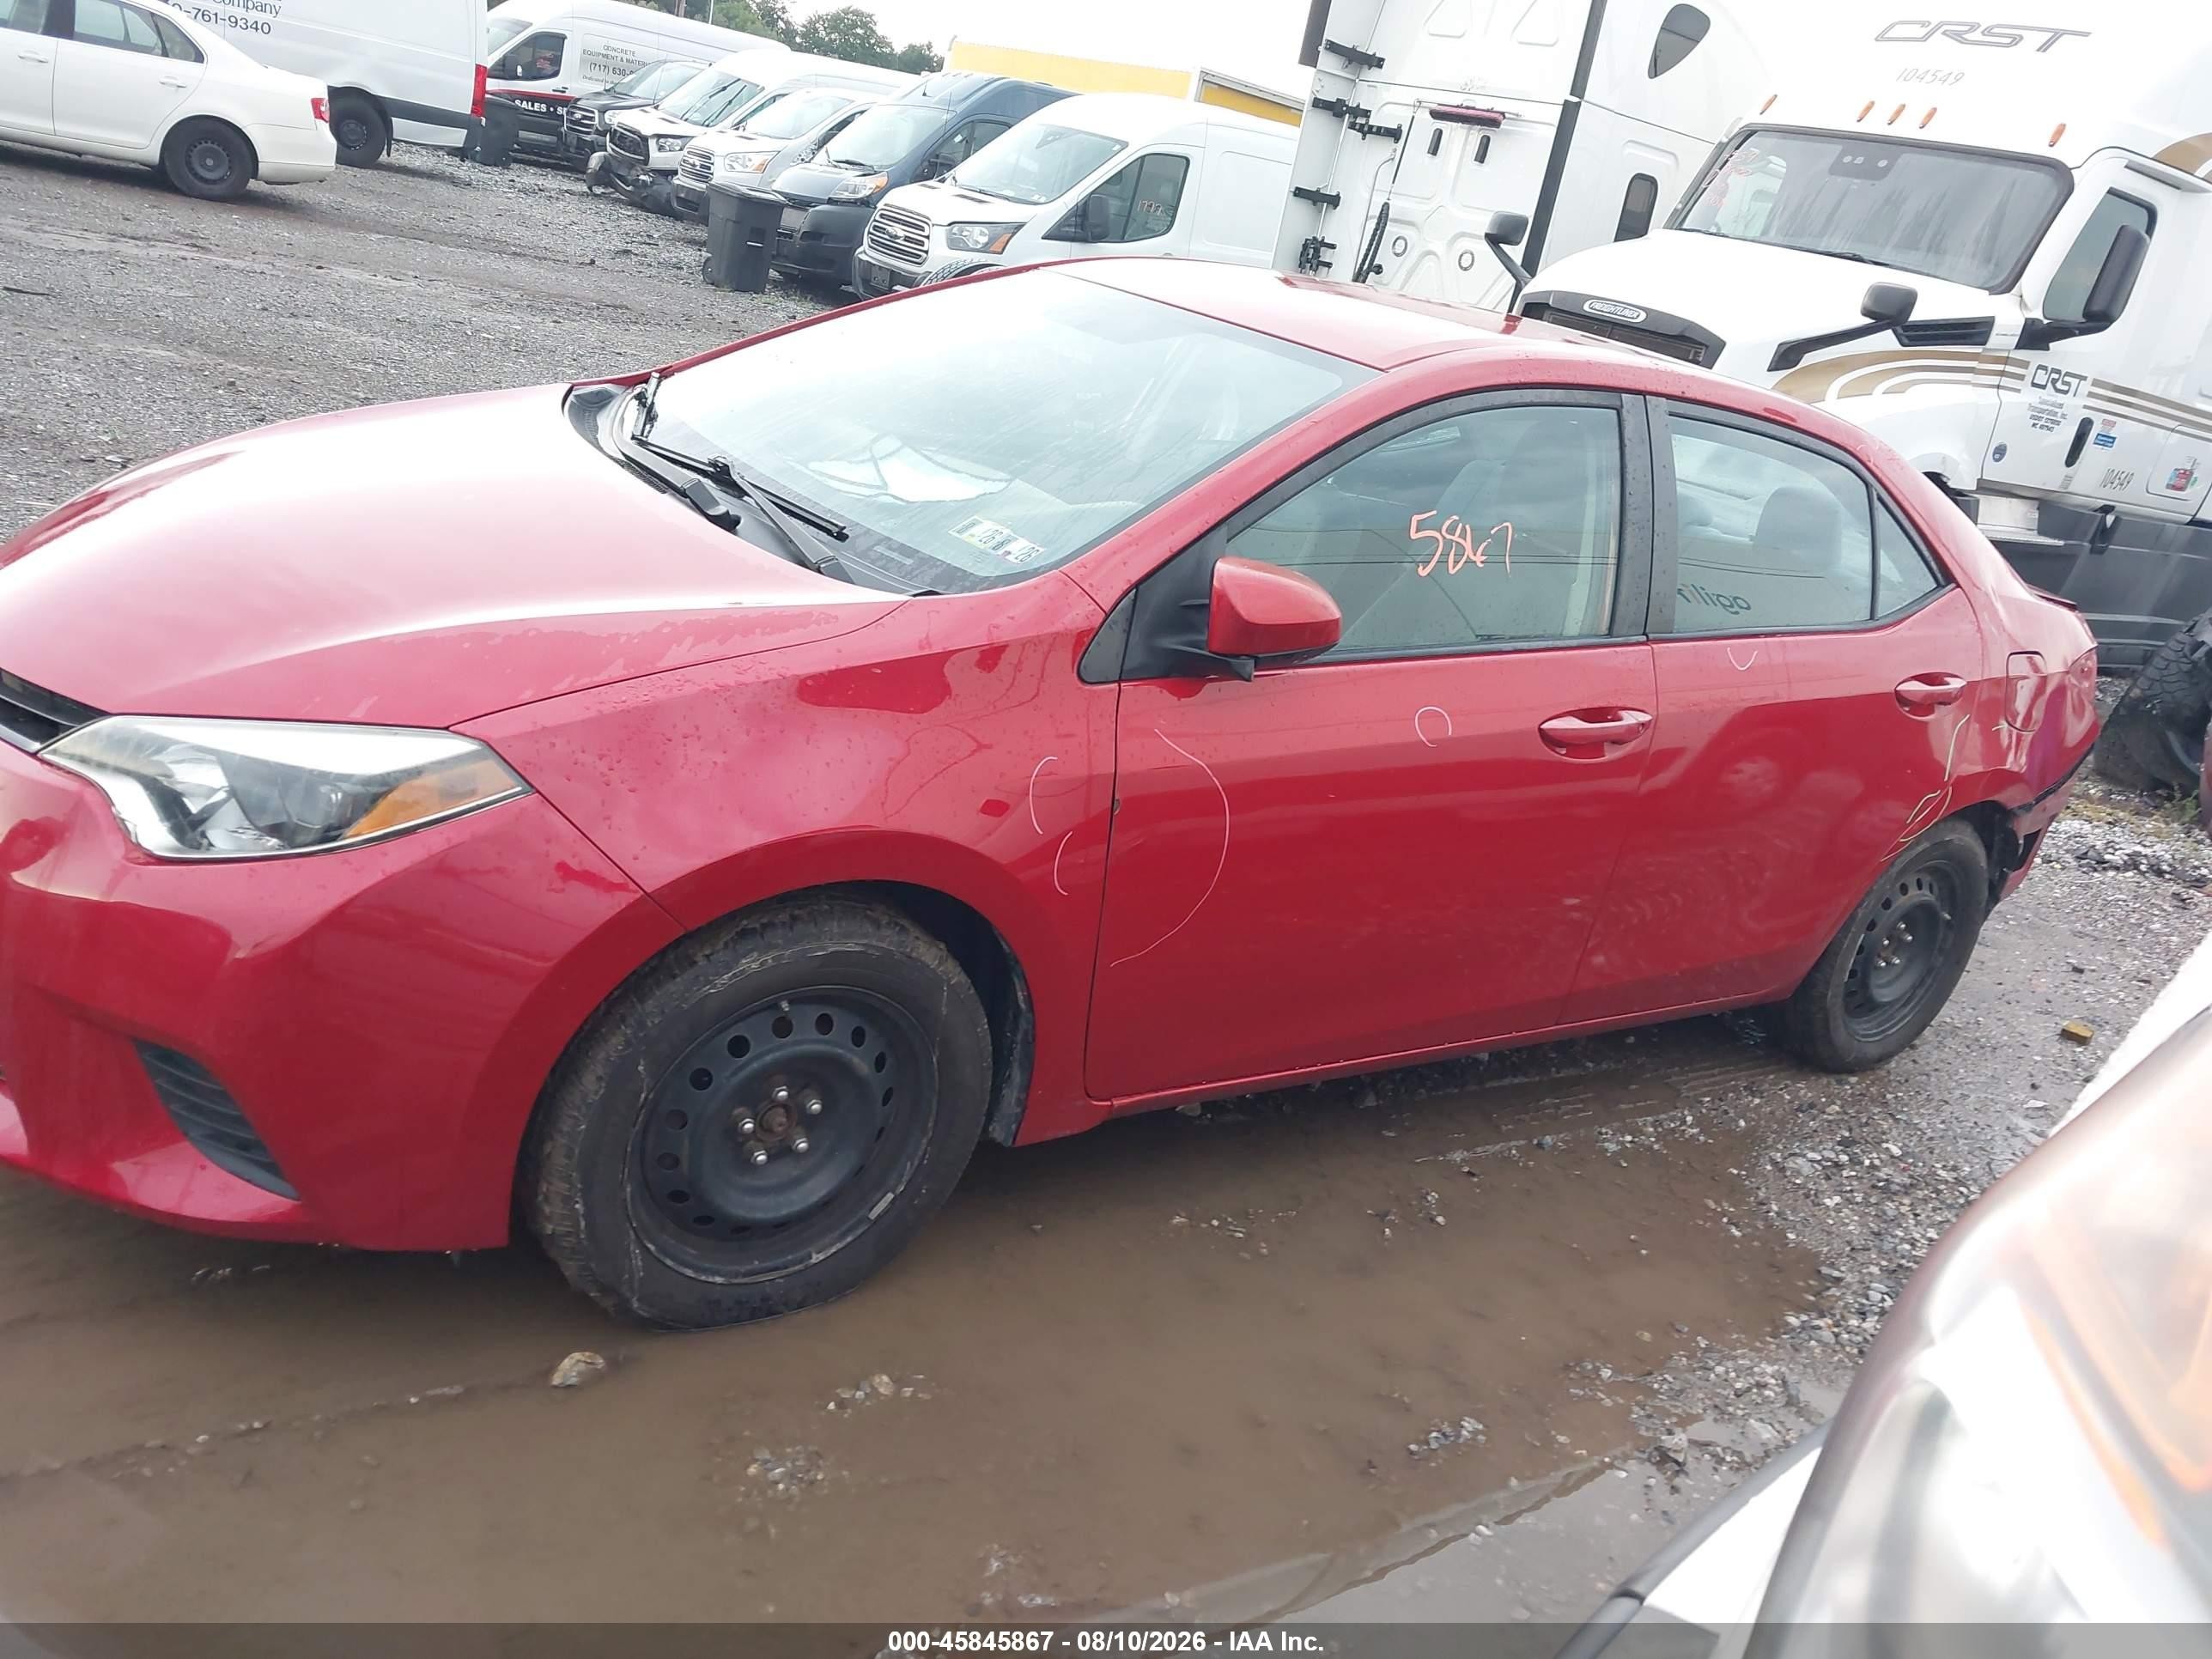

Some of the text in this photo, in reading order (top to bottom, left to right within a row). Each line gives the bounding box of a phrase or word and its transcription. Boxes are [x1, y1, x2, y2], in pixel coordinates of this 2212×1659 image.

[212, 0, 282, 18] ompany
[1875, 20, 2092, 52] CRST
[582, 49, 618, 62] EQUIPMENT
[603, 45, 635, 57] CONCRETE
[589, 62, 610, 76] (717)
[1896, 68, 1965, 86] 104549
[514, 99, 547, 112] SALES
[2031, 364, 2087, 398] CRST
[2099, 468, 2135, 491] 104549
[1410, 510, 1513, 576] 5867
